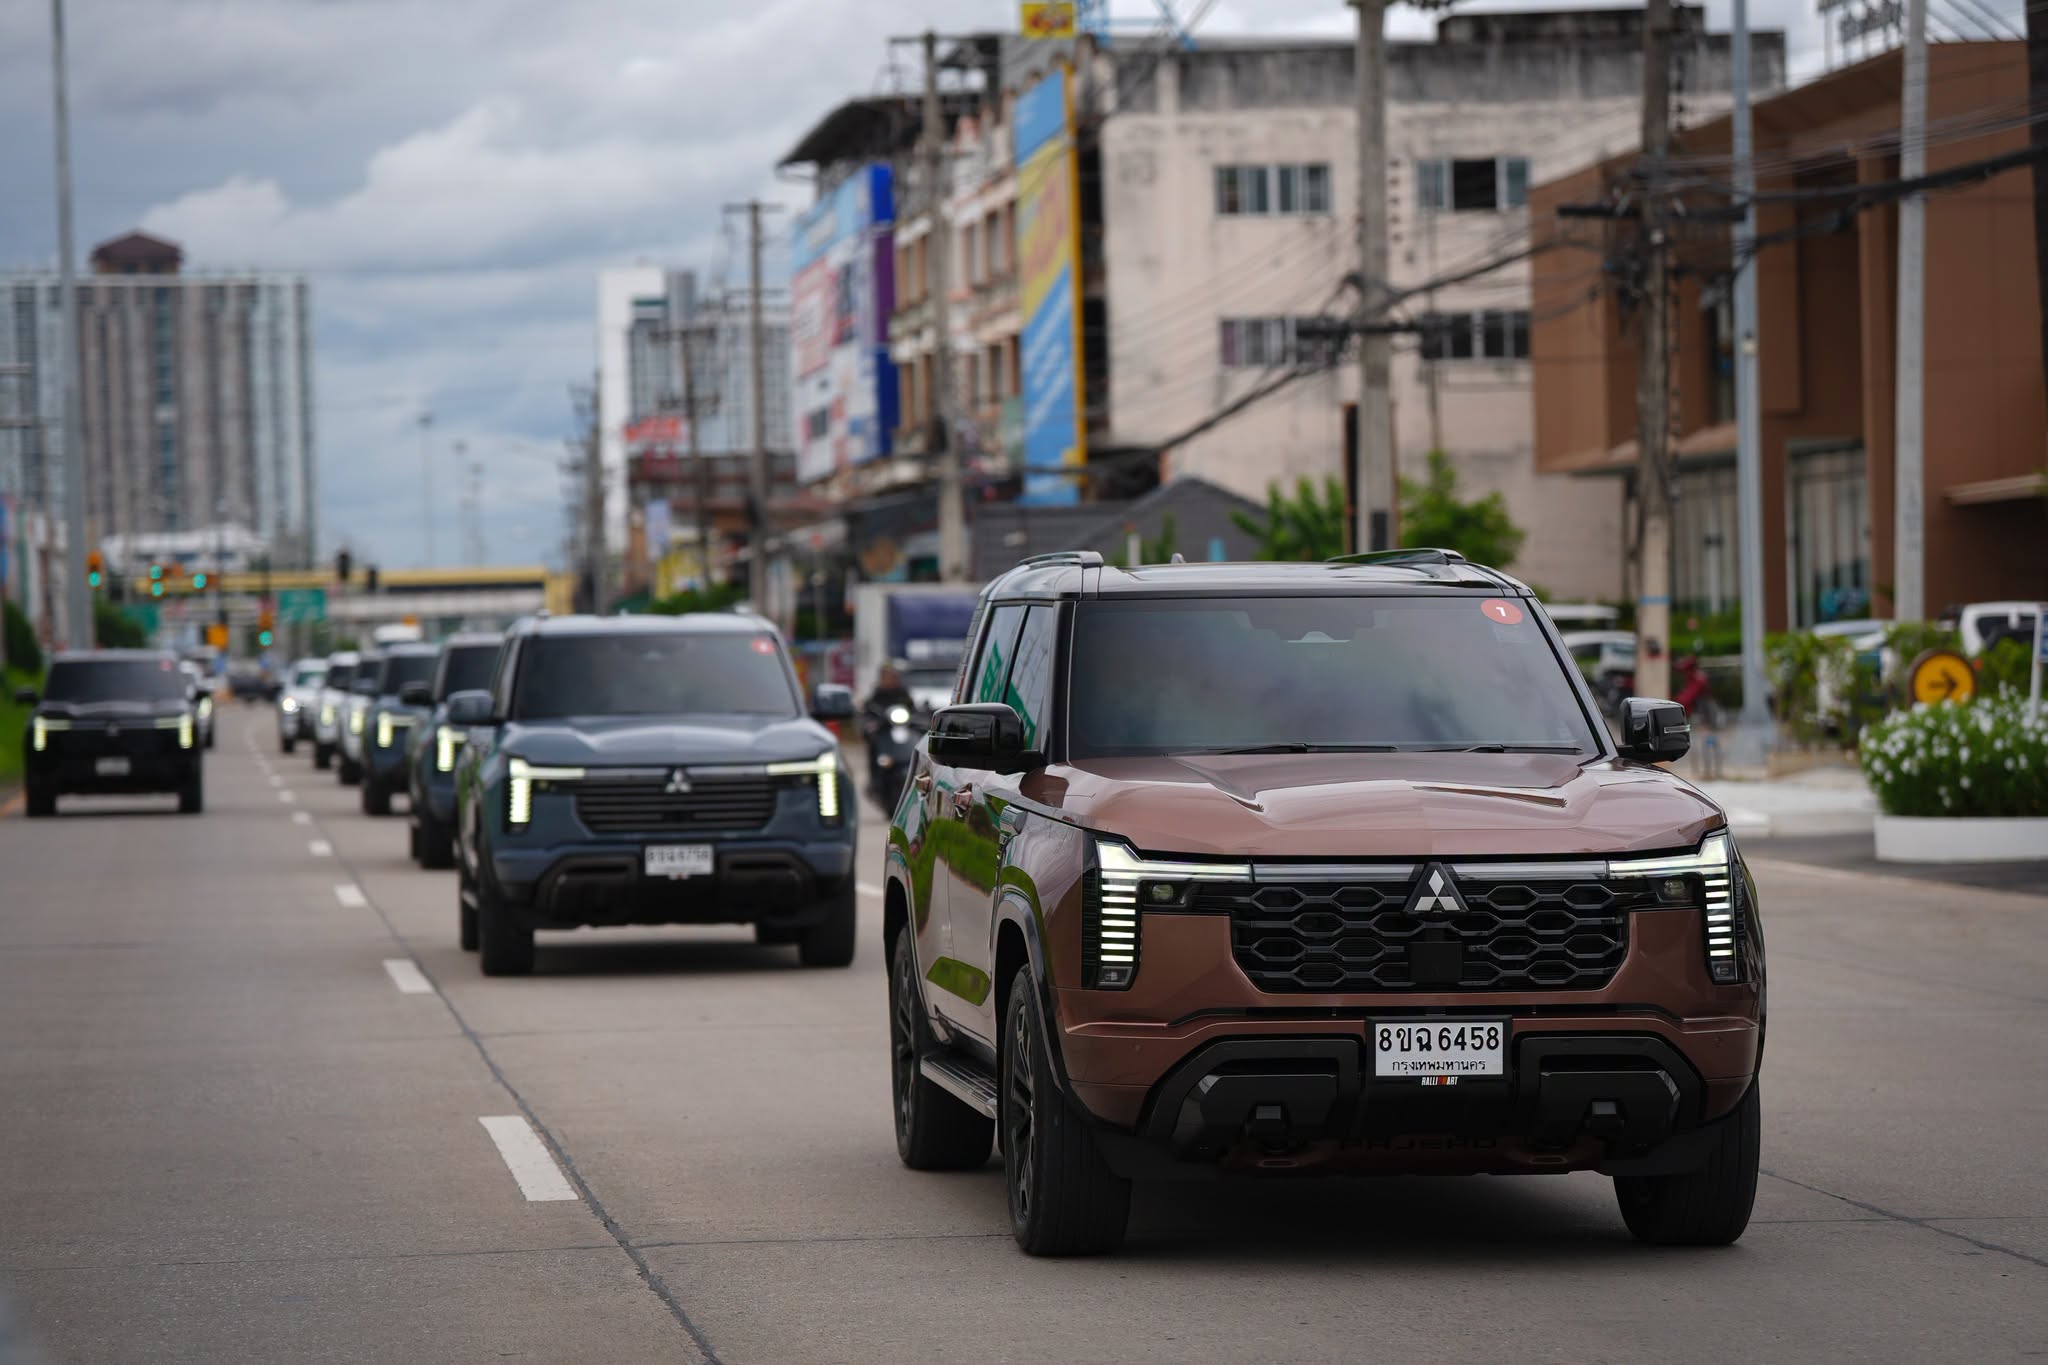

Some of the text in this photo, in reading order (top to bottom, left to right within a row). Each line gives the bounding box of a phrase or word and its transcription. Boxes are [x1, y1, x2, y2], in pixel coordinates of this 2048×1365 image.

[1392, 1060, 1486, 1075] กรุงเทพมหานคร
